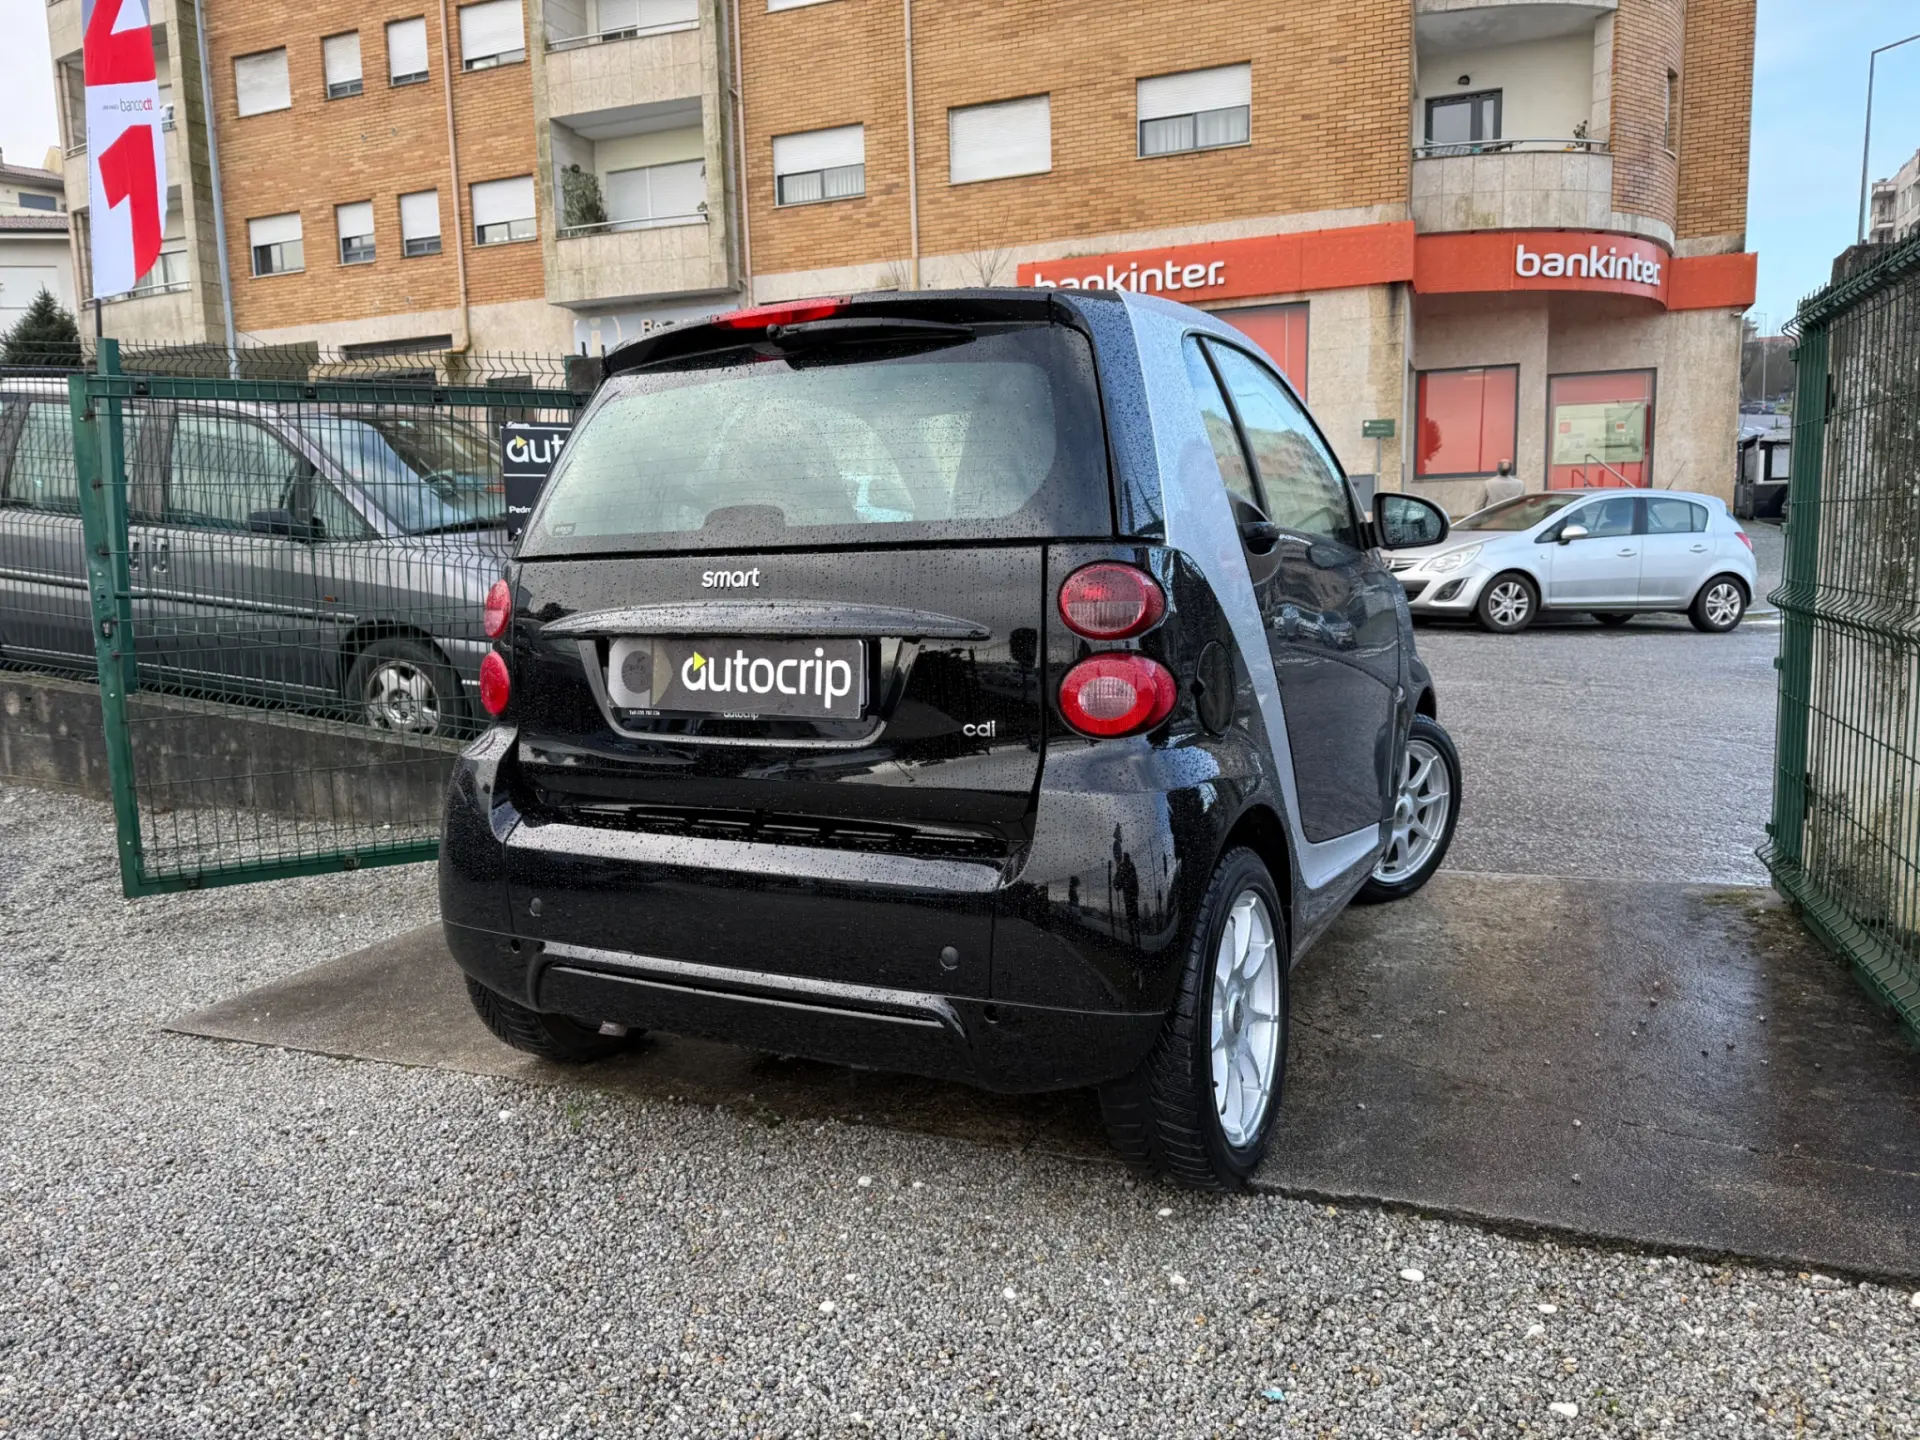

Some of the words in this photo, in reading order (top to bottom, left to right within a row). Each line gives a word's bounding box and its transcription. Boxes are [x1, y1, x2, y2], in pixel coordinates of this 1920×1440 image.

[701, 567, 760, 588] smart
[681, 647, 851, 709] autocrip
[963, 720, 996, 738] cdi
